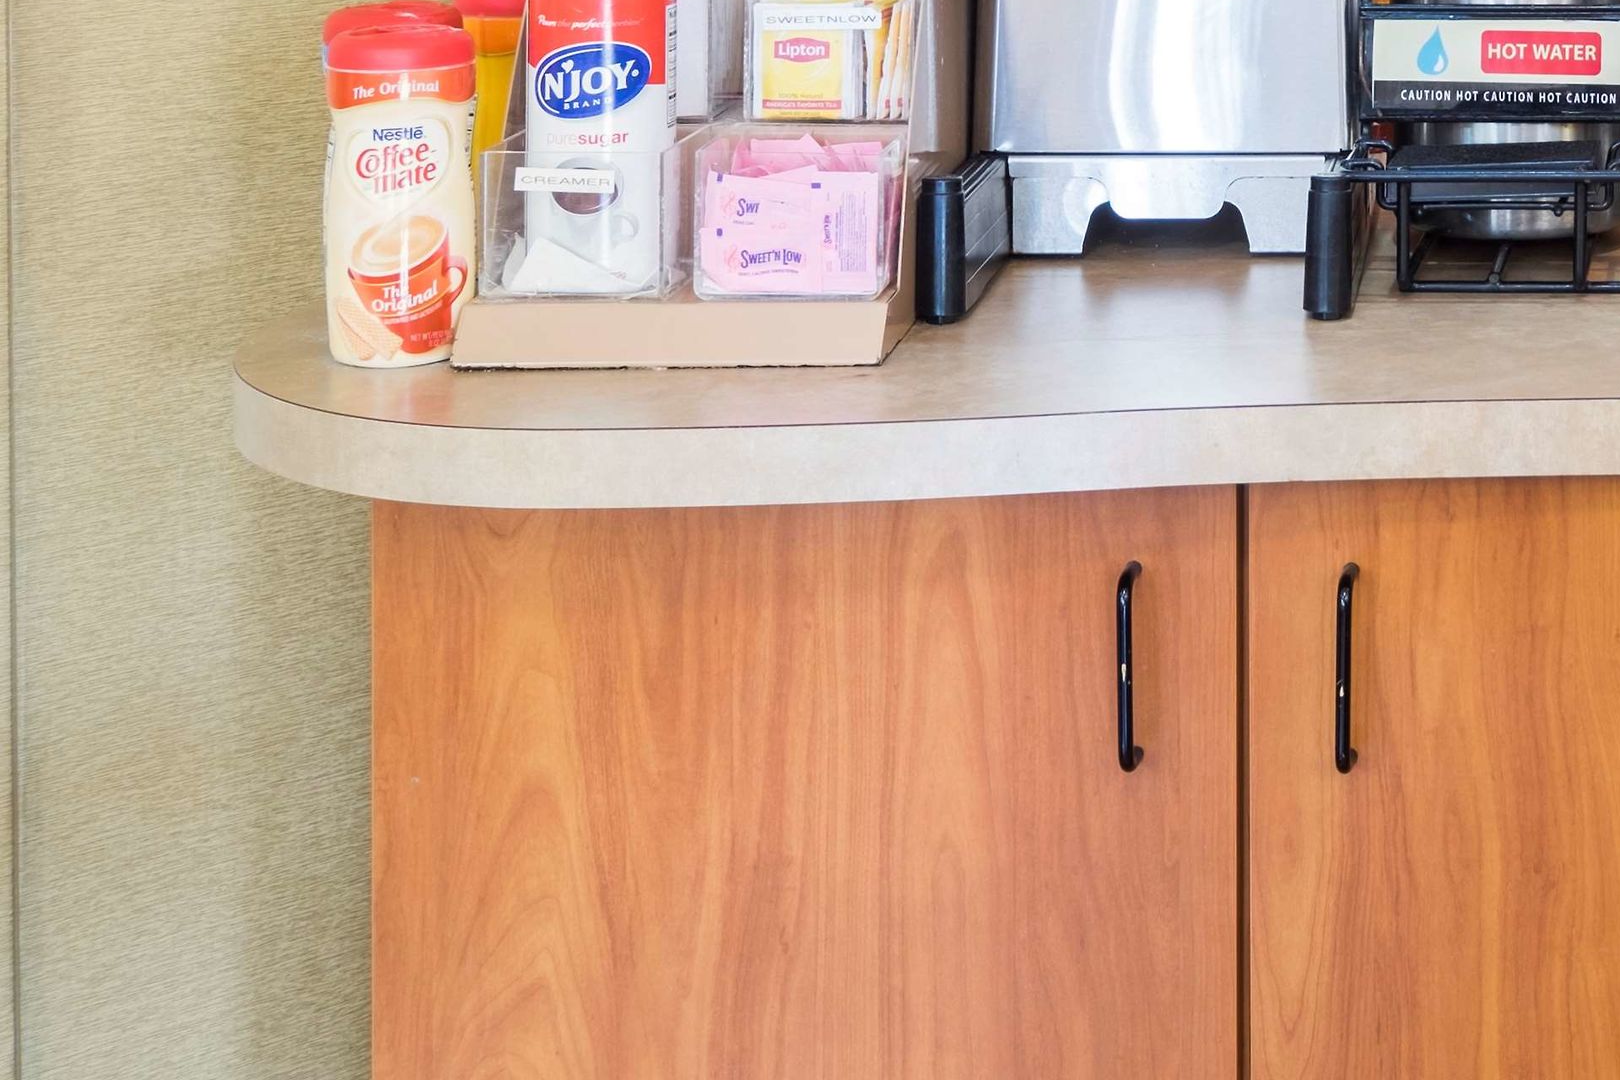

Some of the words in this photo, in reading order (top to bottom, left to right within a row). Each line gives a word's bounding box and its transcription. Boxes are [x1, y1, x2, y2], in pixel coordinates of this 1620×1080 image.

[766, 15, 877, 24] SWEETNLOW
[778, 43, 825, 58] Lipton
[1487, 43, 1528, 60] HOT
[1532, 44, 1596, 61] WATER
[353, 86, 375, 100] The
[1400, 89, 1451, 101] CAUTION
[1456, 90, 1478, 102] HOT
[1483, 91, 1534, 103] CAUTION
[1539, 92, 1561, 104] HOT
[1566, 93, 1617, 105] CAUTION
[374, 162, 437, 195] mate
[521, 176, 611, 186] CREAMER
[783, 248, 802, 265] LOW
